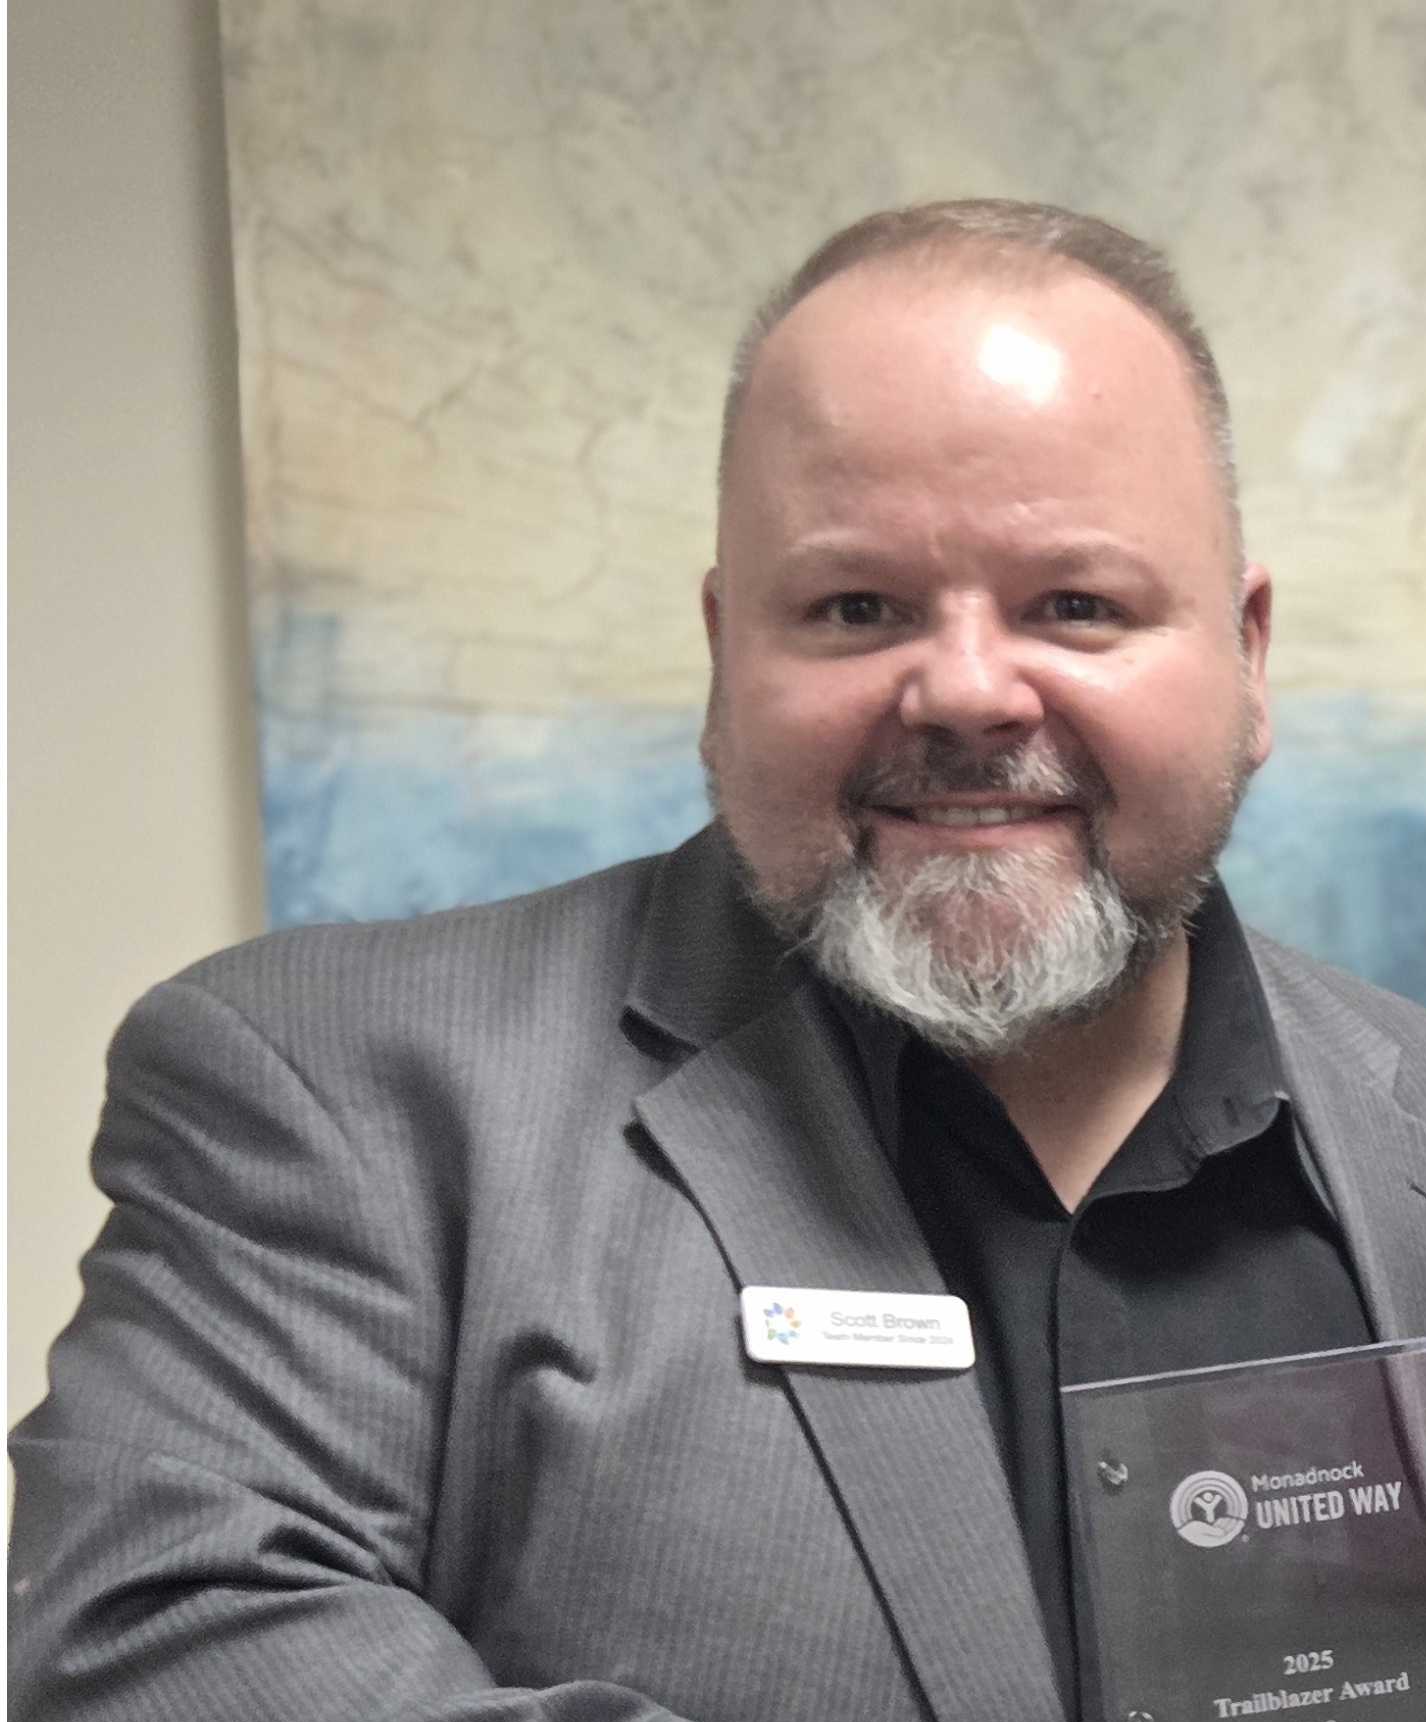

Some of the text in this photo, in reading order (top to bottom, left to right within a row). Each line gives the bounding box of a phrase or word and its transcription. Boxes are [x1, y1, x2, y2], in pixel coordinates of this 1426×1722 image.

[830, 1311, 942, 1330] Scott Brown
[1250, 1460, 1365, 1492] Monadnock
[1255, 1481, 1402, 1529] UNITED WAY
[1283, 1650, 1334, 1675] 2025
[1213, 1671, 1410, 1718] Trailblazer Award
